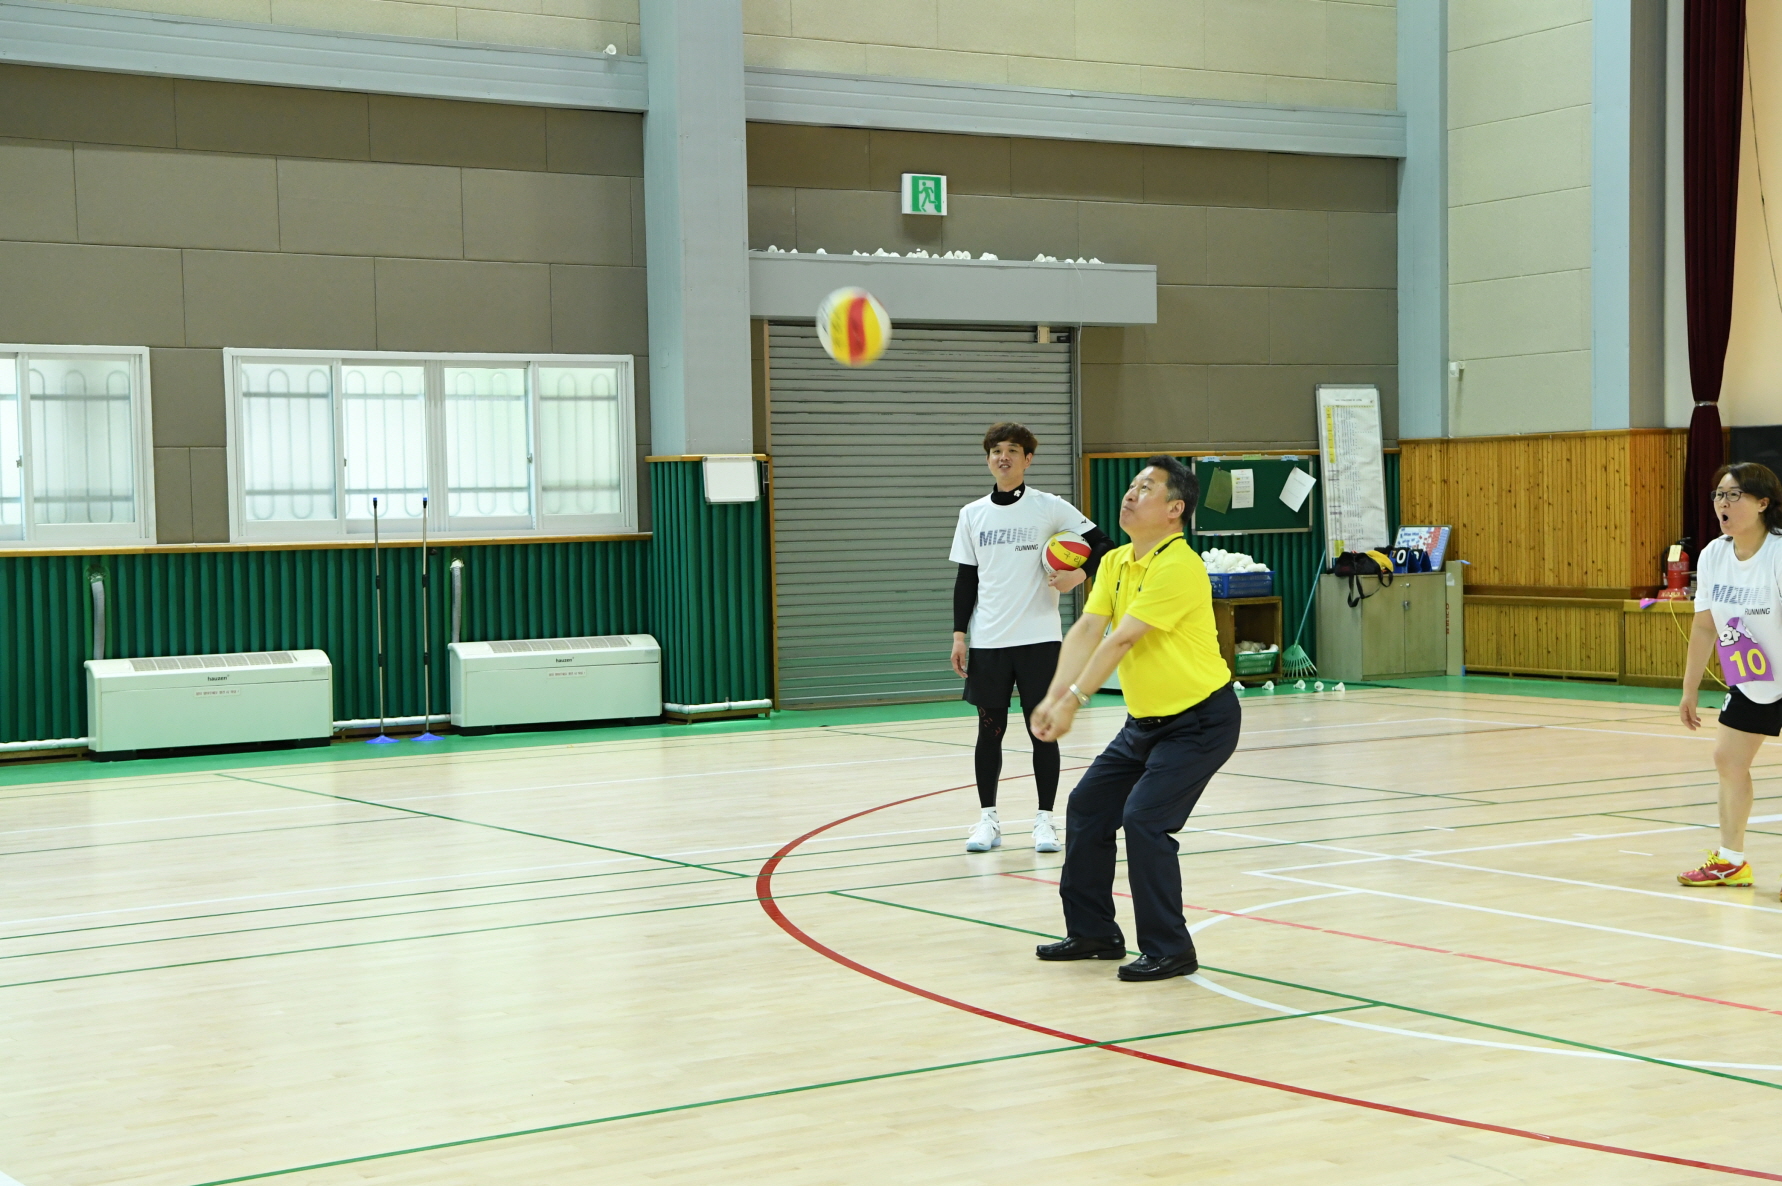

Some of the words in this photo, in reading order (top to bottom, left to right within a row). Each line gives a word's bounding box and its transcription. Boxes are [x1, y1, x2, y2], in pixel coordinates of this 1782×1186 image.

[979, 525, 1038, 547] MIZUNO
[1014, 543, 1039, 552] RUNNING
[1711, 583, 1770, 606] MIZUNO
[1744, 607, 1771, 616] RUNNING
[1729, 648, 1767, 678] 10
